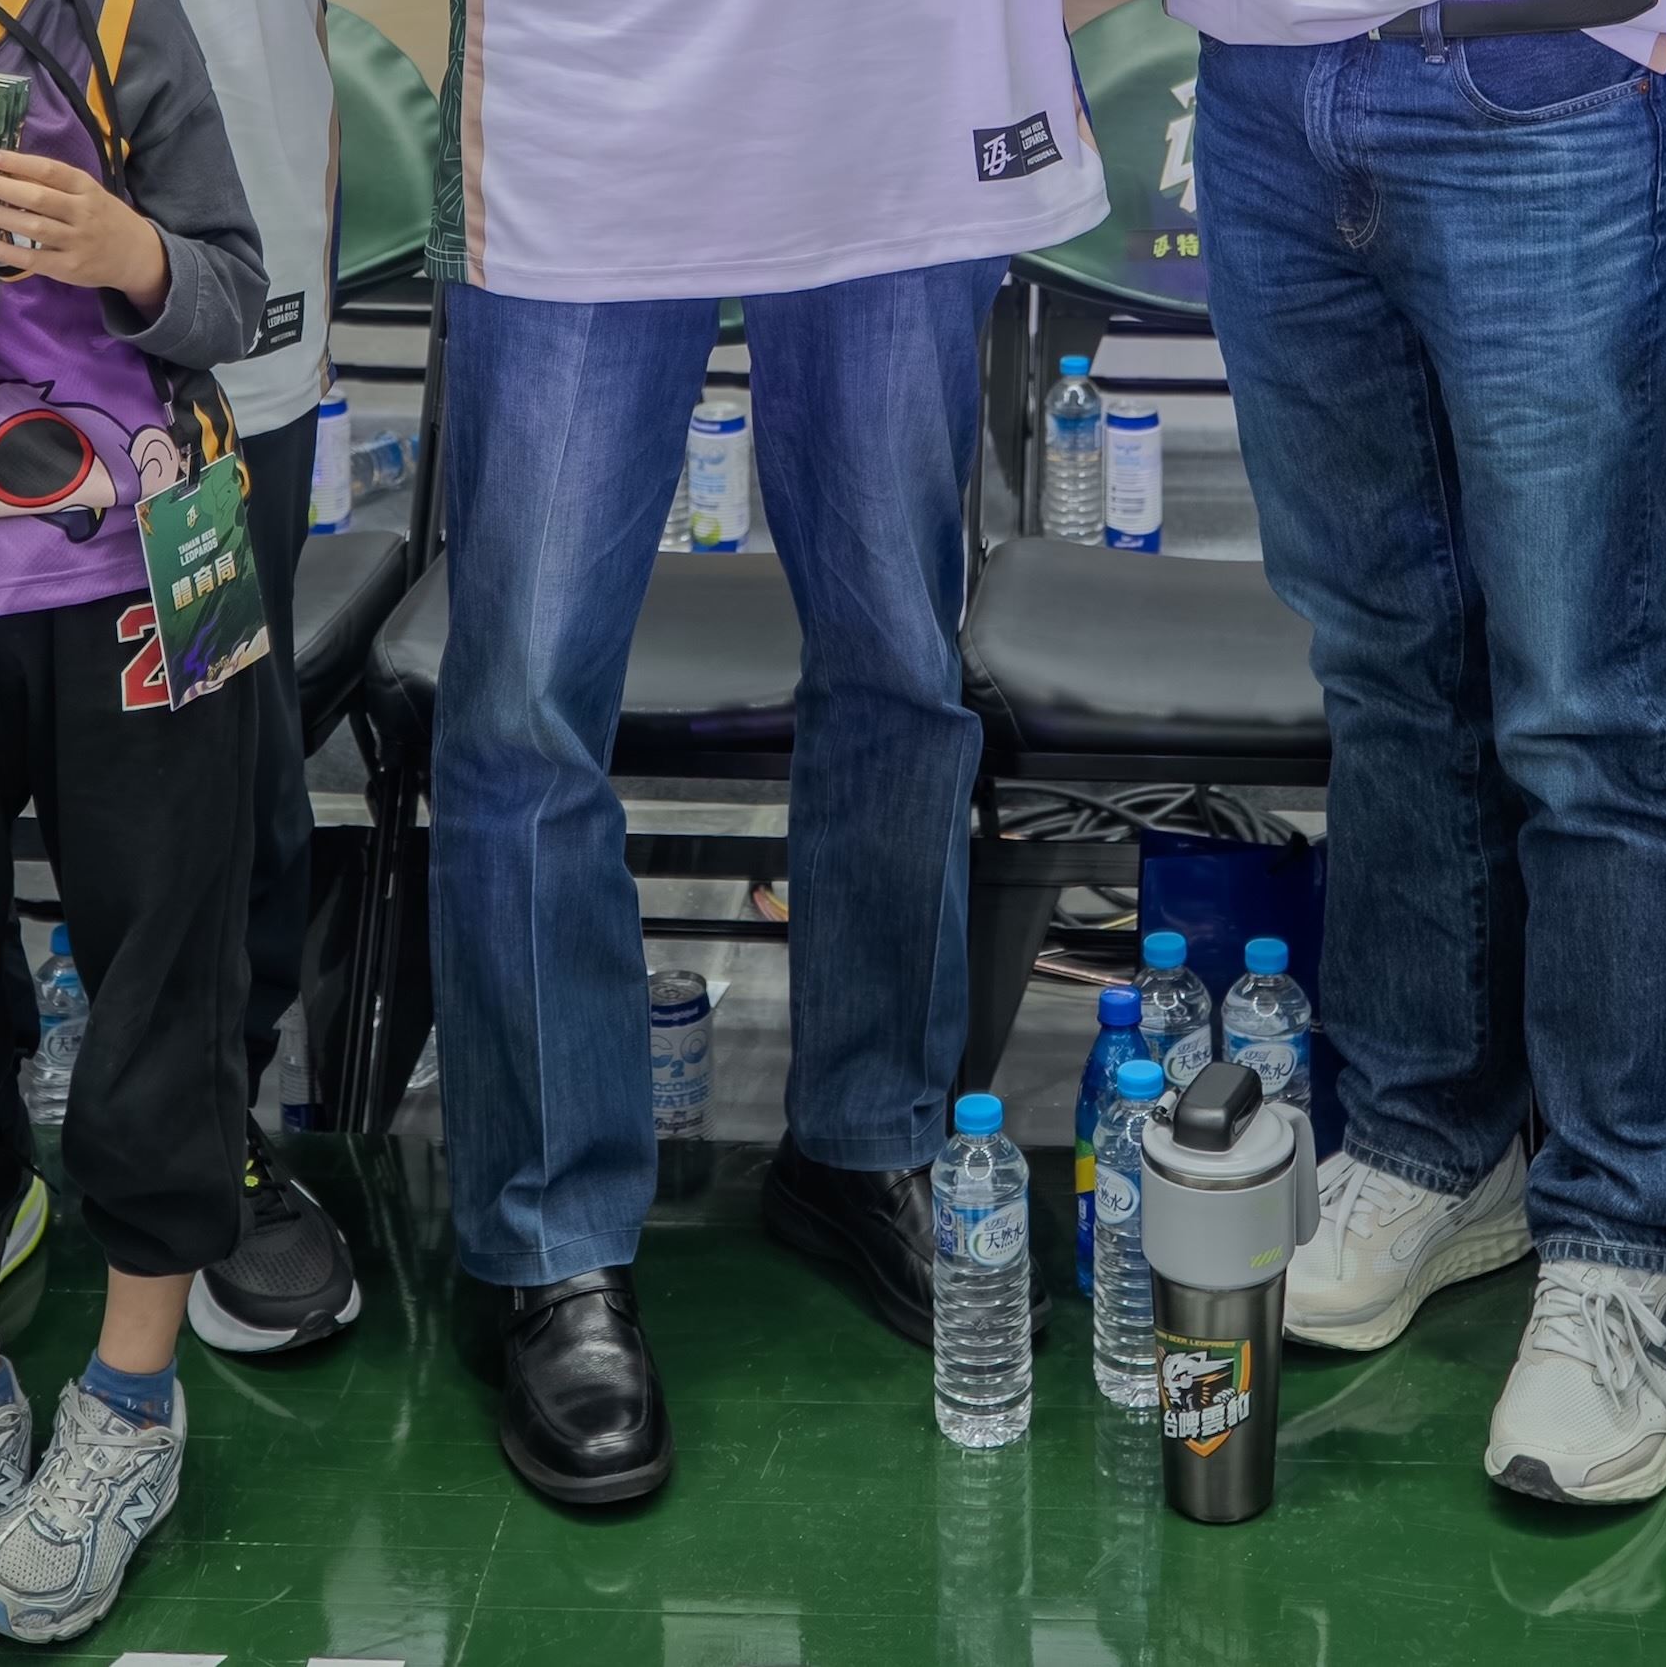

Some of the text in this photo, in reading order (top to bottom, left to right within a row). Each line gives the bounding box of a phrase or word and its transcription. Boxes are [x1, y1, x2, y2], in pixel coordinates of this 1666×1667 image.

[1021, 130, 1049, 151] LEOPARDS
[267, 310, 299, 329] LEOPARDS
[179, 535, 219, 566] LEOPARDS
[171, 550, 237, 611] 體育局
[984, 1221, 1026, 1252] 天然水
[1163, 1389, 1252, 1438] 台啤雲豹
